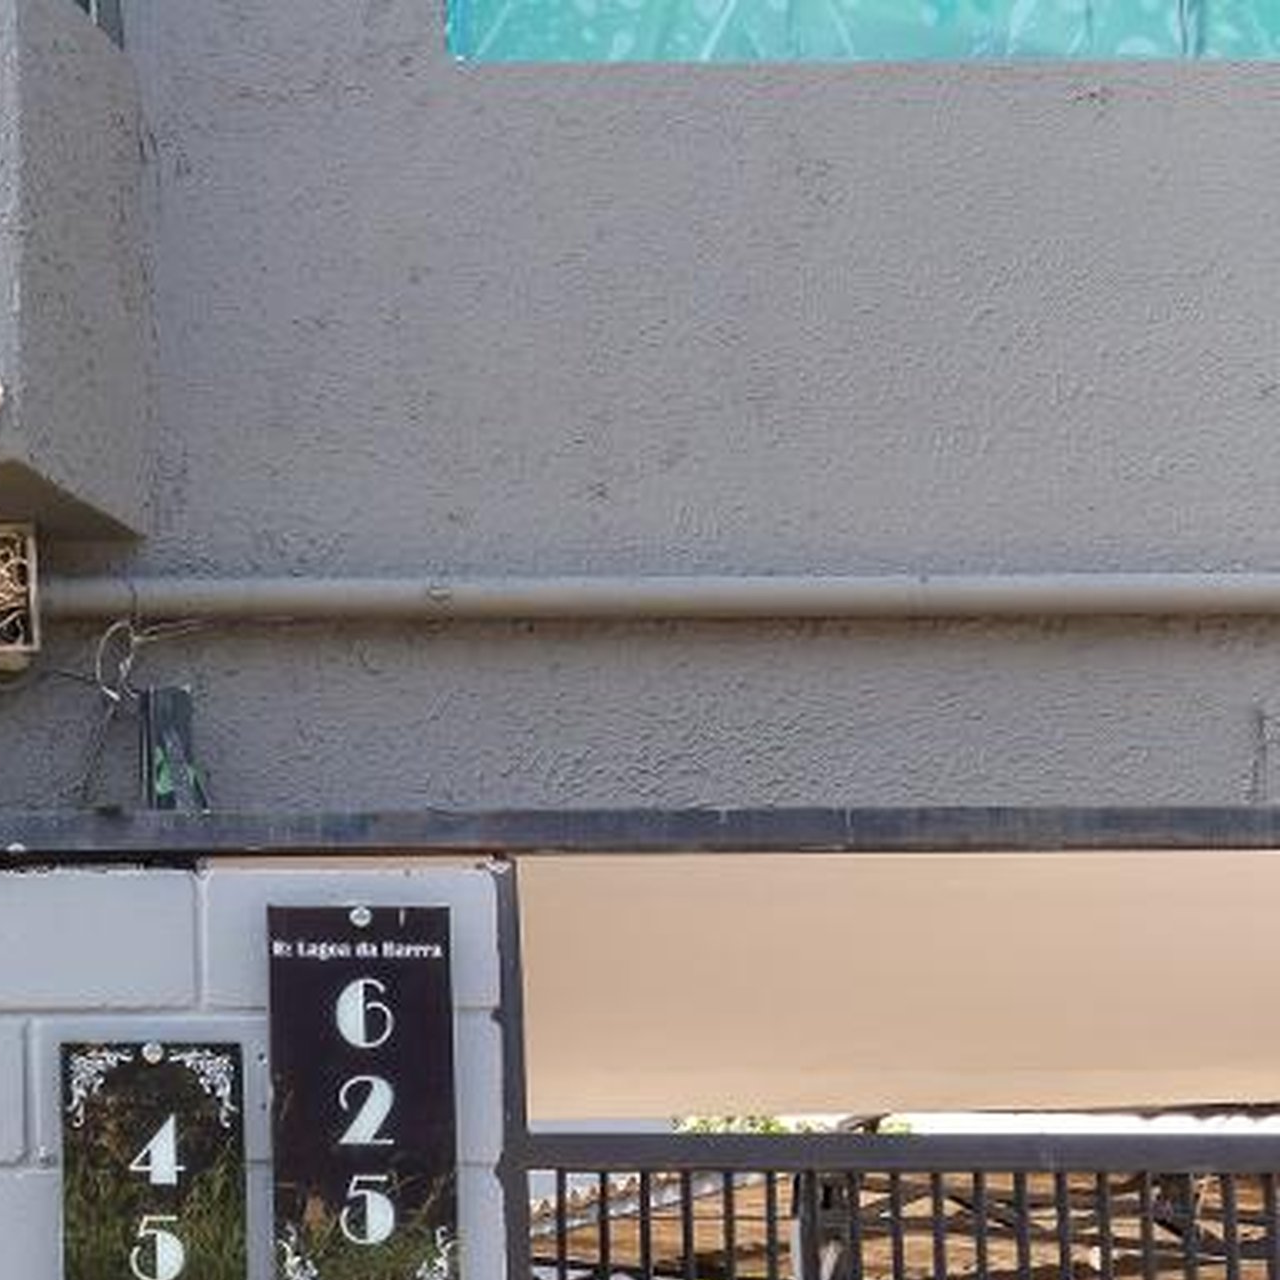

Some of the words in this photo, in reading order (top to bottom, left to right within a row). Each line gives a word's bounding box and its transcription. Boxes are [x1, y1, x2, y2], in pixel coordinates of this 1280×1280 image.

[297, 941, 351, 961] Lagoa
[356, 941, 378, 957] da
[336, 978, 396, 1245] 625
